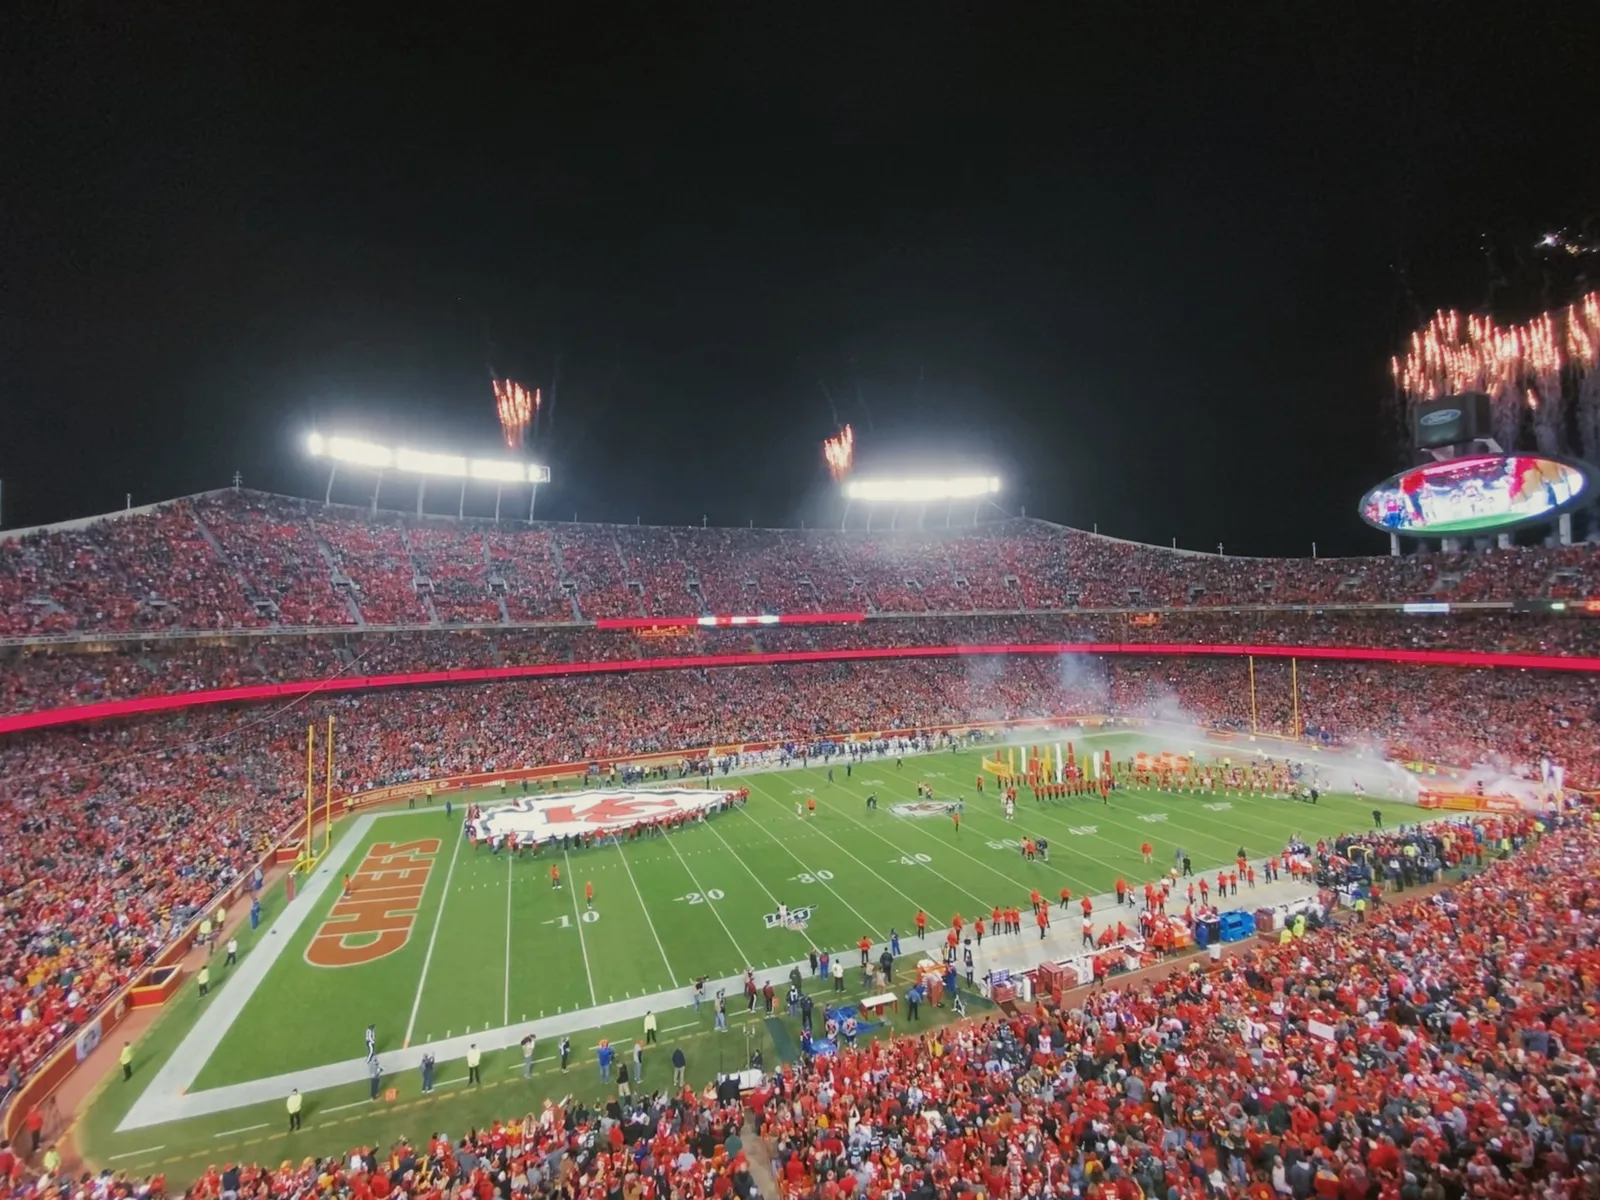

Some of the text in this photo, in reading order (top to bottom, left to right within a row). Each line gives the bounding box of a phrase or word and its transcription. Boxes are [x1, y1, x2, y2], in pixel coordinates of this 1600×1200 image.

[900, 853, 932, 866] 40
[797, 869, 834, 884] 30
[303, 838, 443, 968] CHIEFS
[685, 889, 725, 905] 20
[556, 910, 600, 929] 10
